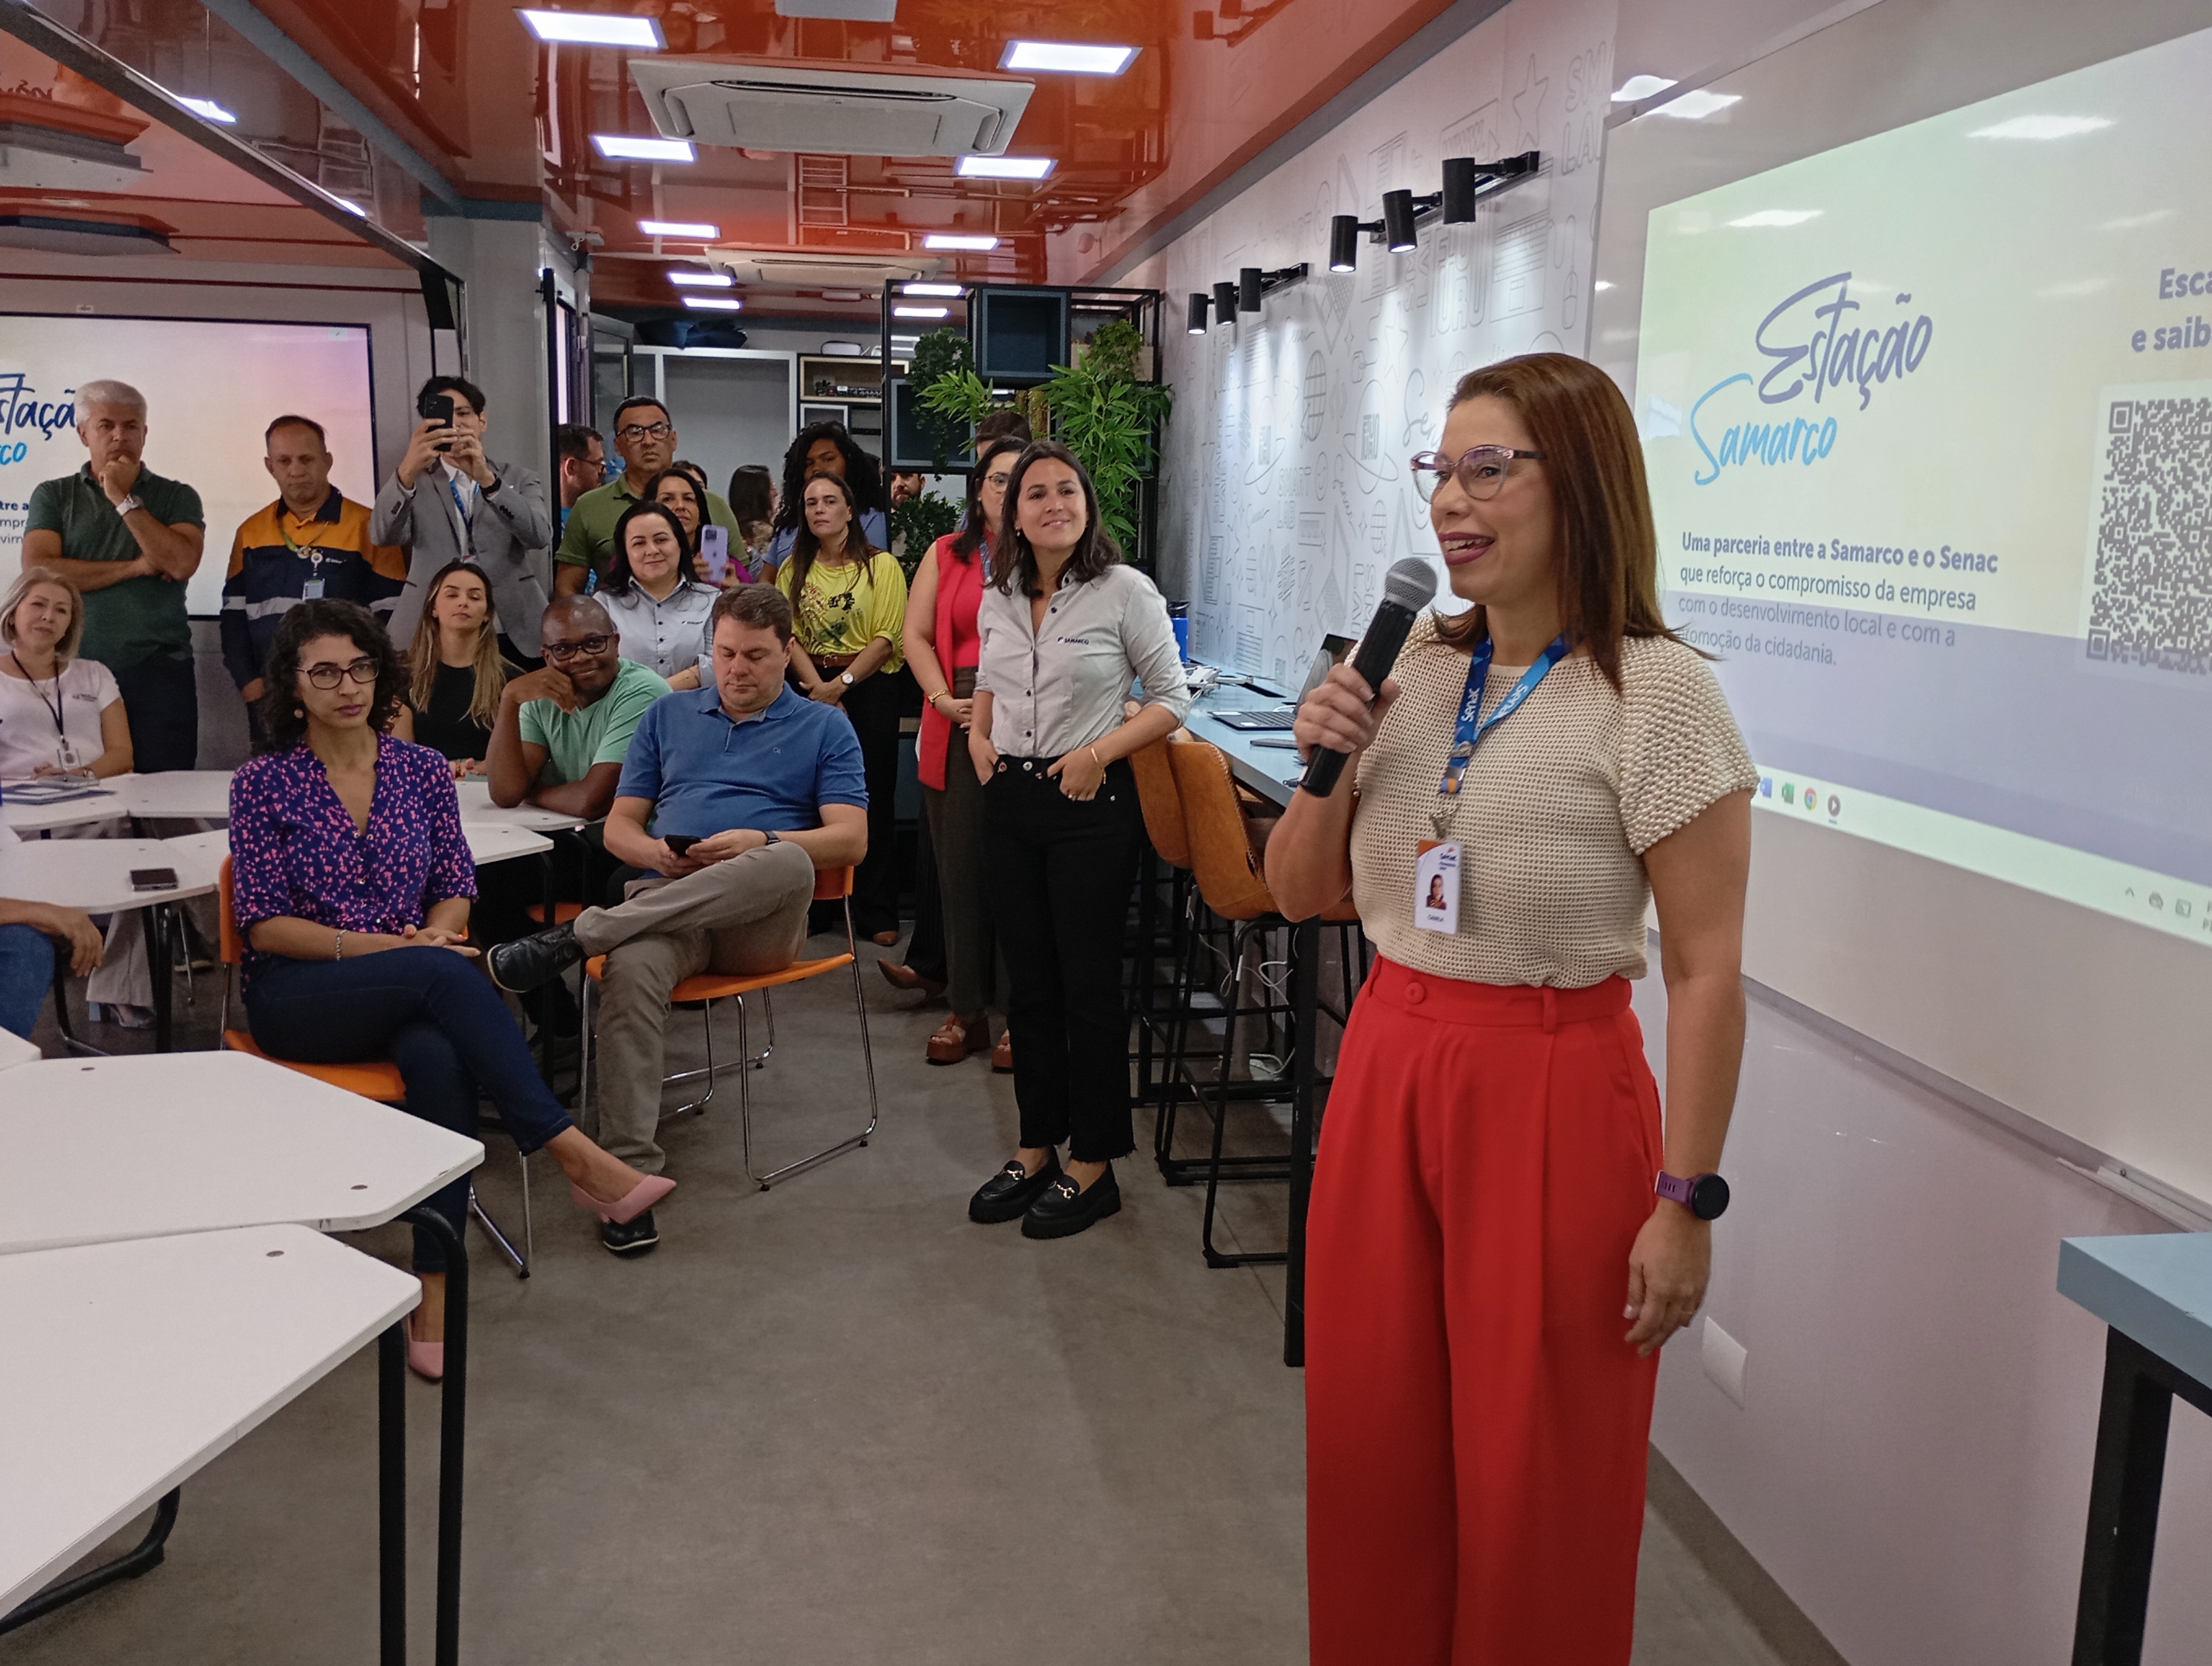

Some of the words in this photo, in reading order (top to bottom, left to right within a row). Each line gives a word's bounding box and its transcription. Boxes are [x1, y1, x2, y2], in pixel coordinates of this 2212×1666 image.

[1756, 271, 1933, 411] Estação
[2132, 329, 2146, 353] e
[0, 373, 76, 441] staçã
[1690, 372, 1837, 485] Samarco
[1682, 532, 1711, 552] Uma
[1714, 535, 1770, 557] parceria
[1774, 539, 1814, 559] entre
[1817, 542, 1826, 559] a
[1830, 538, 1904, 565] Samarco
[1908, 549, 1919, 566] e
[1923, 550, 1935, 568] o
[1940, 545, 1998, 573] Senac
[1681, 567, 1703, 586] que
[1707, 565, 1752, 591] reforça
[1756, 573, 1765, 588] o
[1769, 574, 1870, 598] compromisso
[1875, 579, 1895, 601] da
[1900, 586, 1976, 611] empresa
[1679, 598, 1705, 613] com
[1709, 601, 1717, 615] o
[1721, 598, 1840, 630] desenvolvimento
[1844, 610, 1882, 636] local
[1887, 621, 1896, 638] e
[1902, 624, 1940, 644] com
[1945, 629, 1955, 646] a
[1745, 633, 1761, 653] da
[1765, 636, 1836, 665] cidadania.
[1461, 687, 1481, 722] Senac
